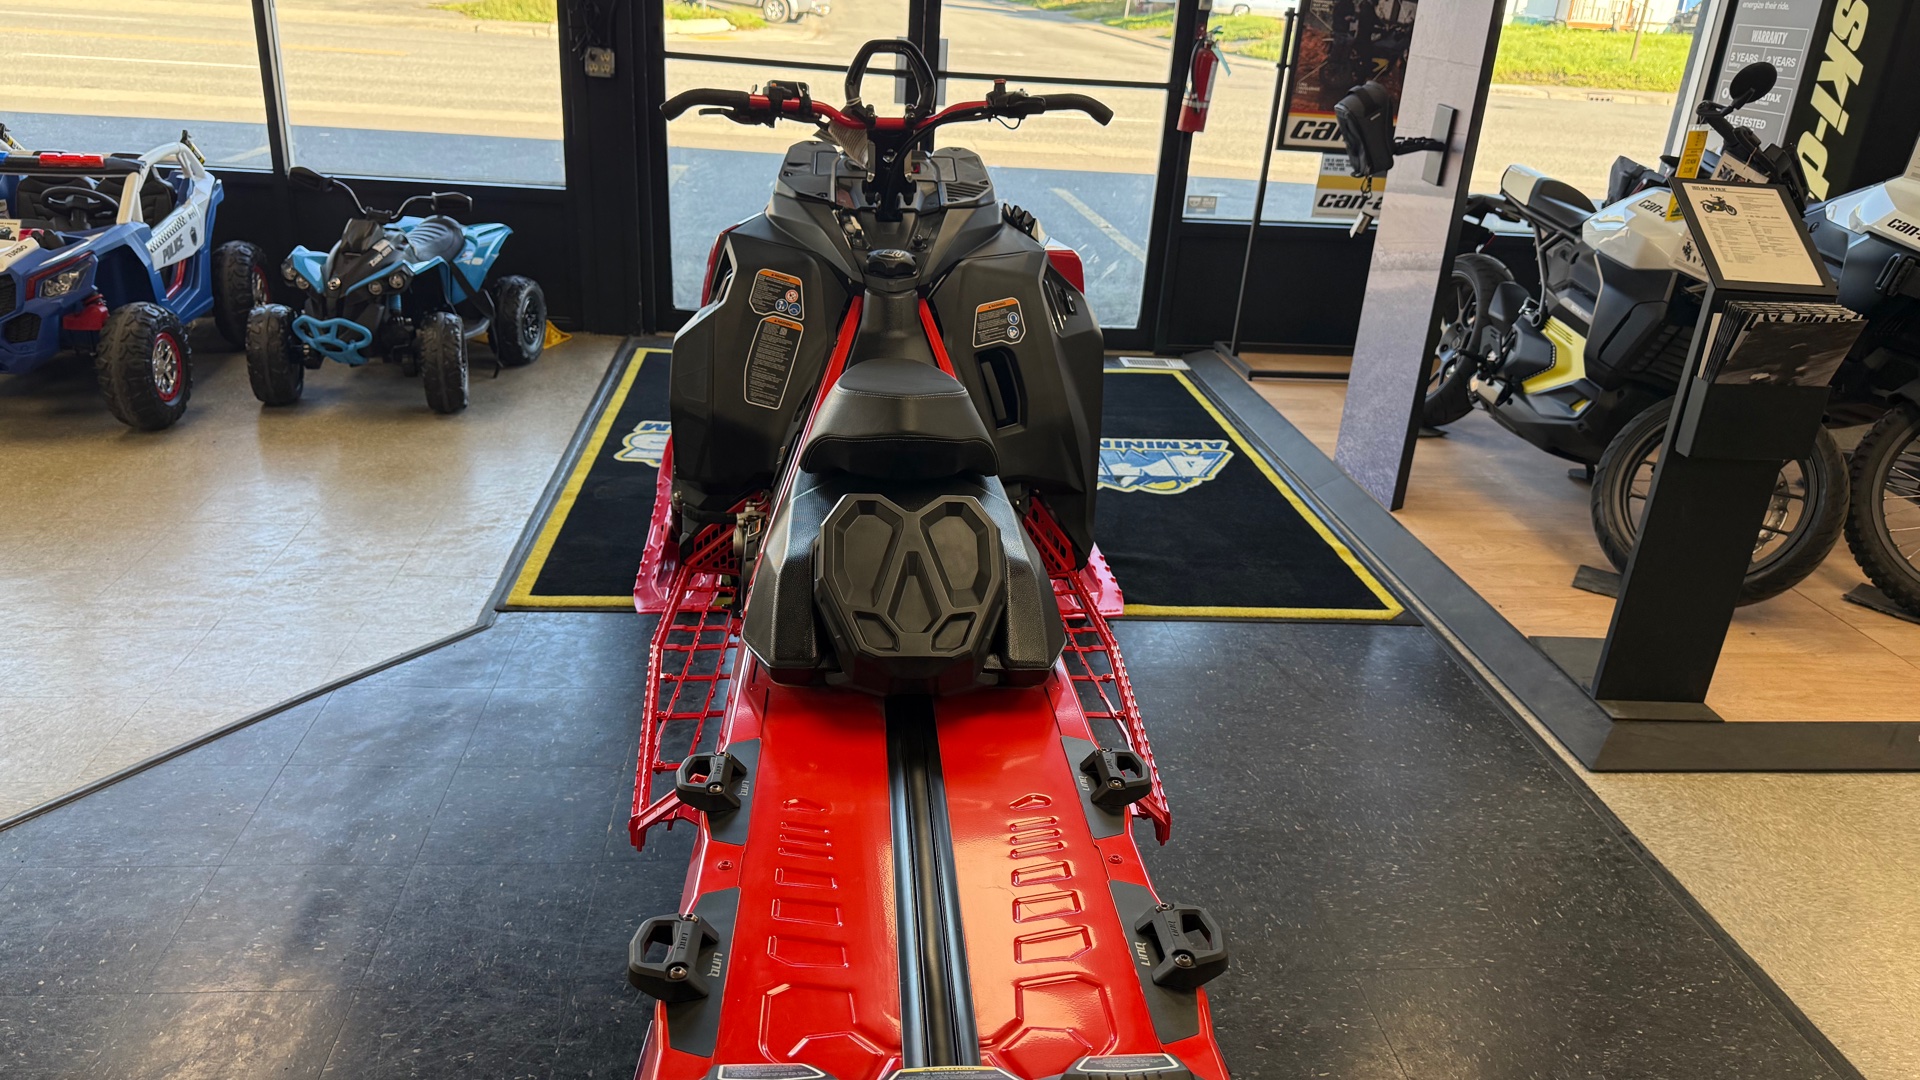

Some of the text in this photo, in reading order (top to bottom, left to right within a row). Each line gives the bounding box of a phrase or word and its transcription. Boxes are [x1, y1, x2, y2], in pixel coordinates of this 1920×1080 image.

[1765, 1, 1777, 10] their
[1751, 30, 1788, 45] WARRANTY
[1730, 52, 1759, 63] 5 YEARS
[1772, 55, 1797, 68] YEARS
[1797, 0, 1869, 202] ski-d
[1887, 218, 1920, 240] can-
[162, 233, 185, 264] POLICE
